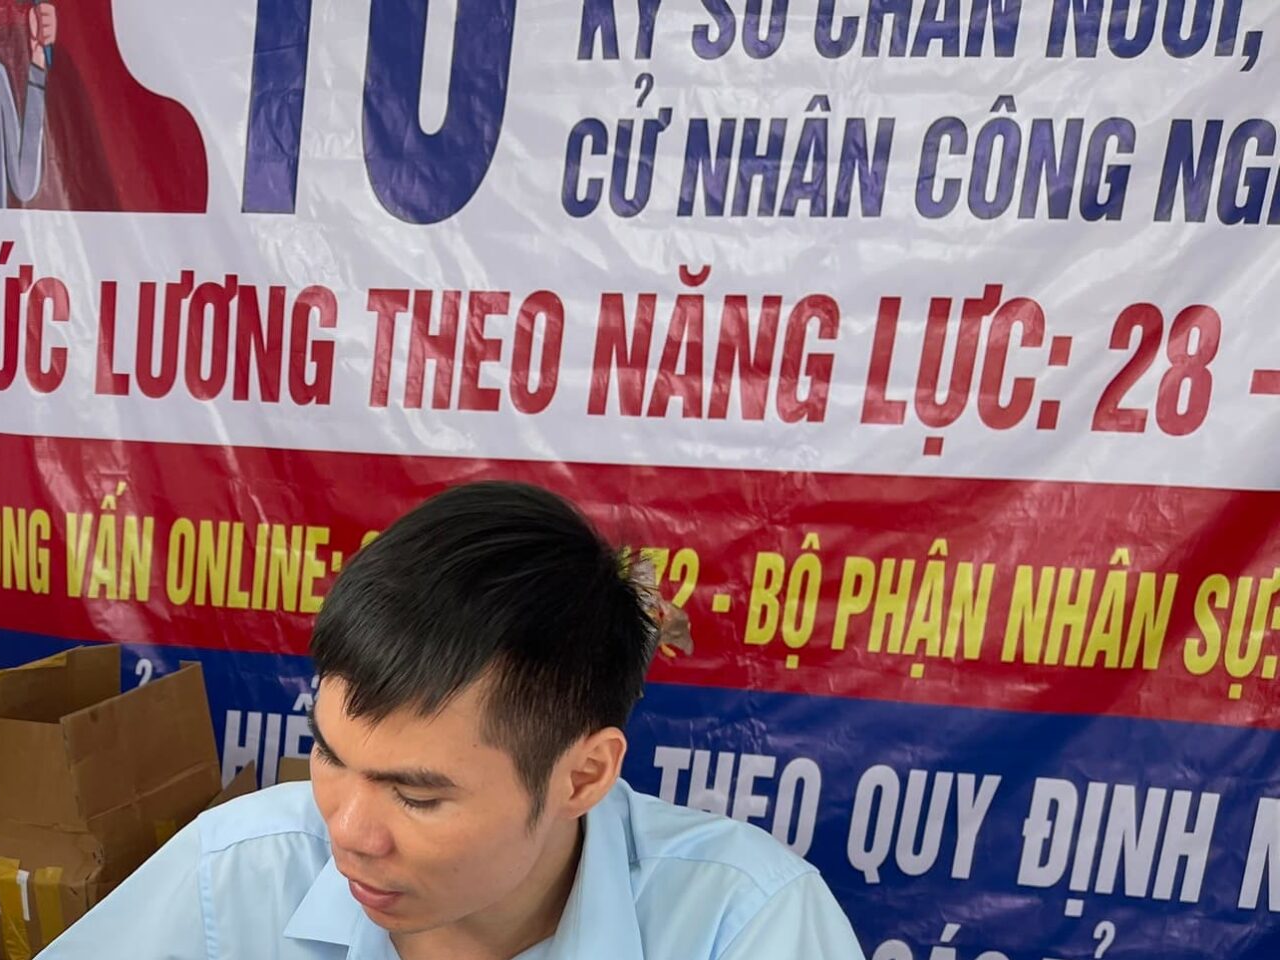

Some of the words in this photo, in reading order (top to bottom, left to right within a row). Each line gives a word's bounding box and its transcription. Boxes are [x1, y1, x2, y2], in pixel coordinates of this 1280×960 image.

[561, 72, 672, 218] CỬ
[676, 94, 895, 217] NHÂN
[914, 95, 1136, 221] CÔNG
[1153, 118, 1280, 225] NG
[95, 269, 338, 406] LƯƠNG
[366, 288, 565, 416] THEO
[588, 264, 840, 423] NĂNG
[860, 283, 1071, 457] LỰC:
[1091, 302, 1221, 436] 28
[66, 480, 155, 601] VẤN
[744, 532, 821, 670] BỘ
[831, 538, 994, 679] PHẬN
[1001, 547, 1178, 669] NHÂN
[847, 764, 1002, 884] QUY
[1017, 776, 1220, 917] ĐỊNH
